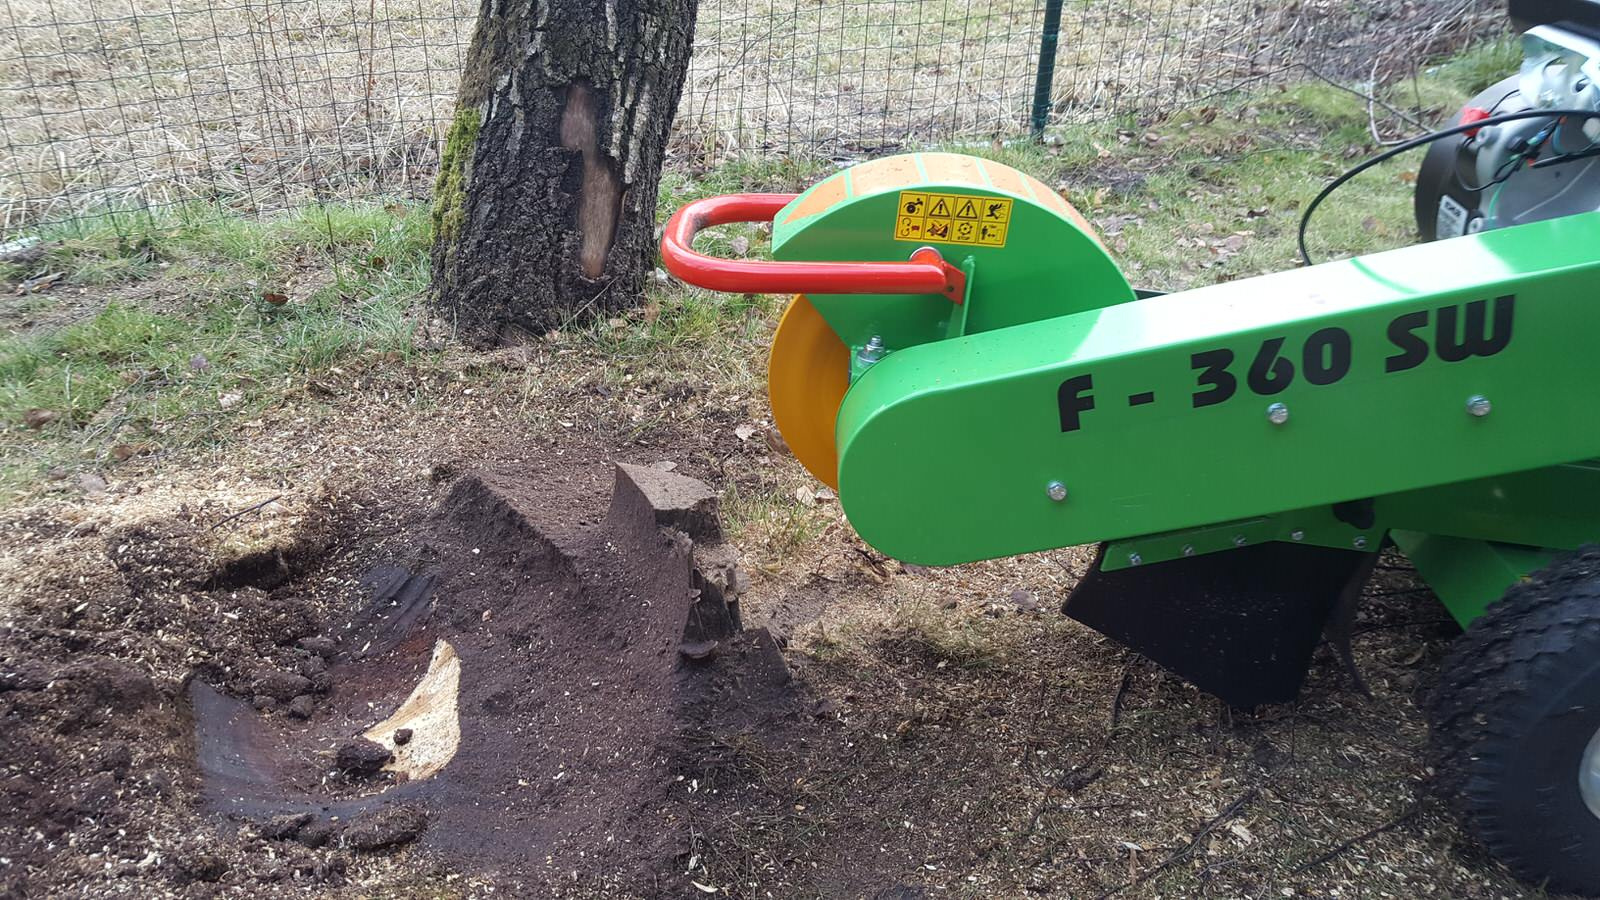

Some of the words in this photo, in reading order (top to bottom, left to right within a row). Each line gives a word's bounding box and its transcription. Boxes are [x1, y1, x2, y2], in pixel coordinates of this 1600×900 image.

[1057, 374, 1095, 433] F
[1191, 327, 1352, 408] 360
[1385, 294, 1516, 373] SW
